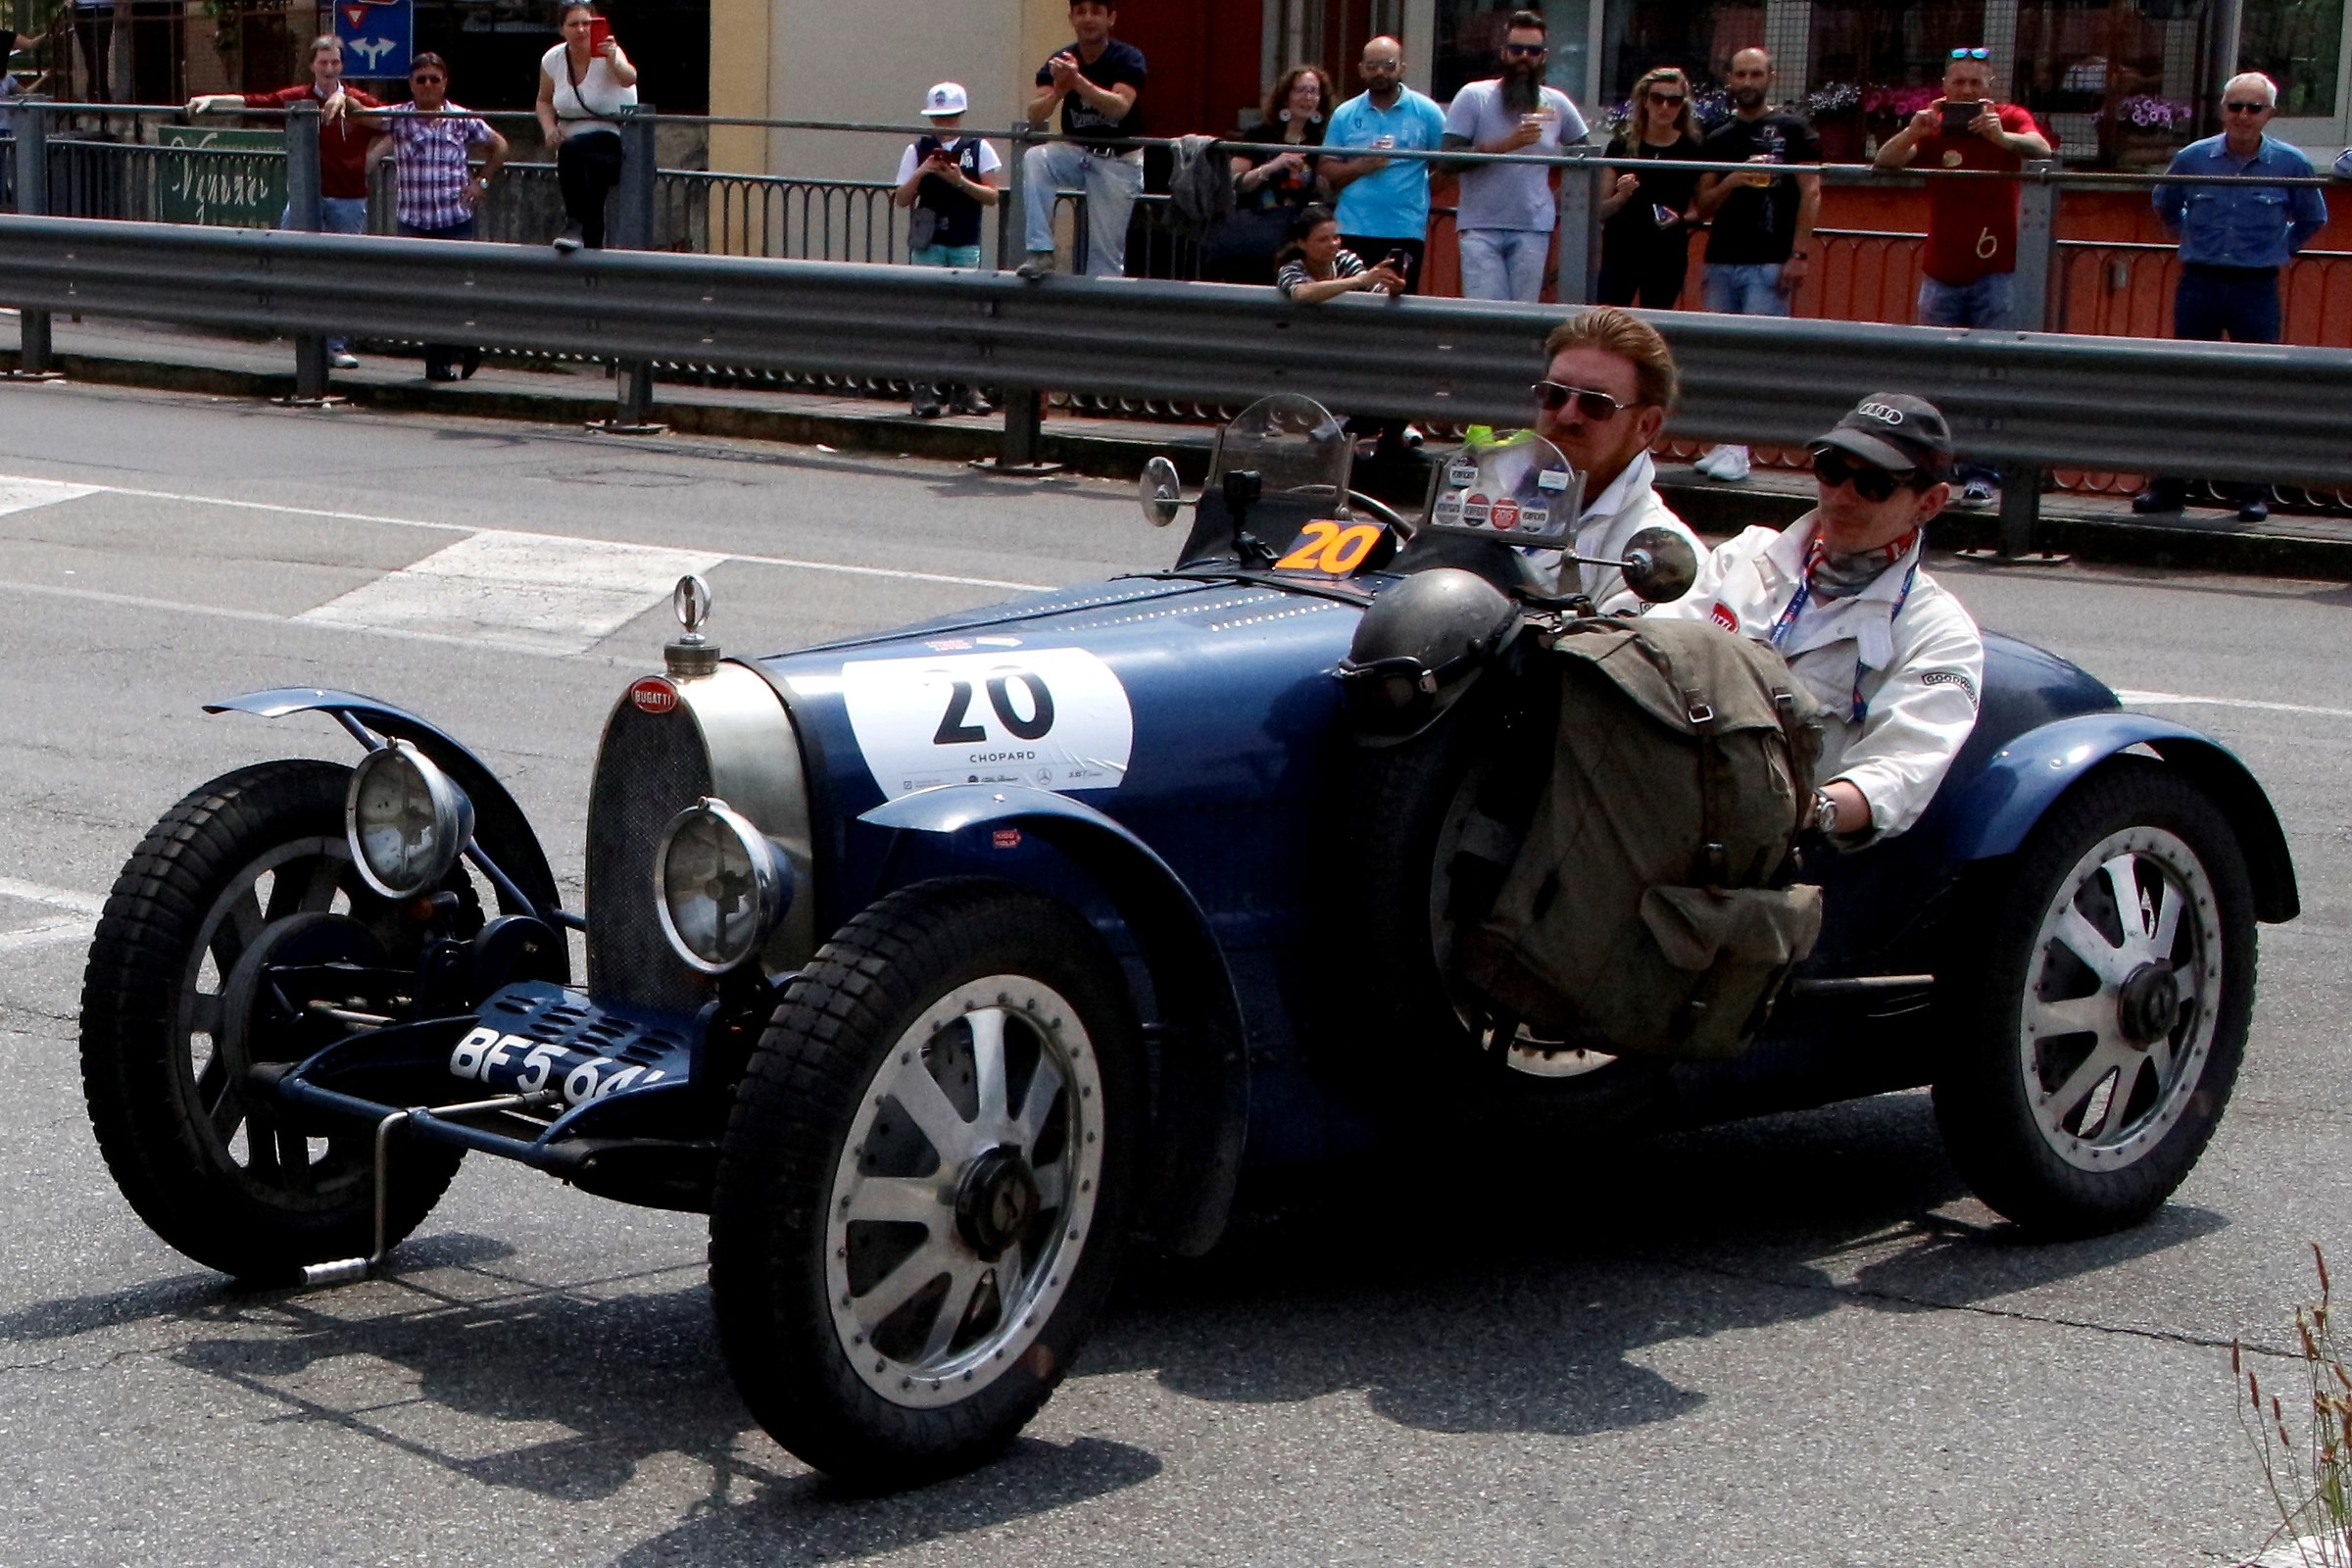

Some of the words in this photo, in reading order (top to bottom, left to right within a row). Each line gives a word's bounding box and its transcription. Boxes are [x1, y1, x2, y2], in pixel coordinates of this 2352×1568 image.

[1976, 226, 1997, 259] 6
[1275, 521, 1381, 573] 20
[634, 690, 671, 706] BUGATTI
[924, 665, 1054, 745] 20
[969, 751, 1036, 763] CHOPARD
